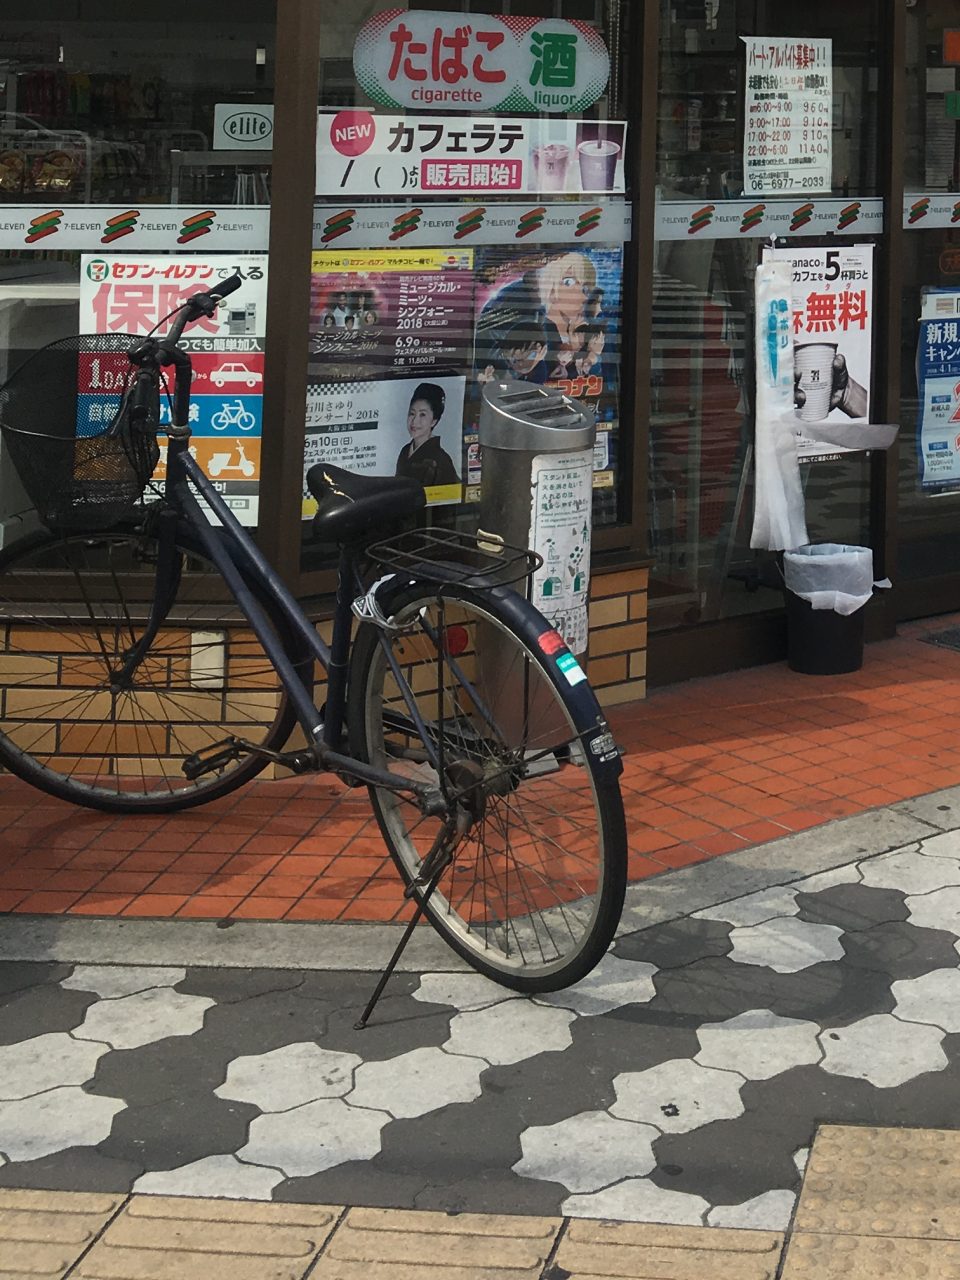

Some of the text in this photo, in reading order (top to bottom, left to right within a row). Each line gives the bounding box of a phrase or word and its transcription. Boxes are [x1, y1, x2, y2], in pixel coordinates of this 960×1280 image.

[387, 22, 579, 88] たばこ 酒
[410, 87, 578, 107] cigarette liquor
[229, 115, 267, 137] elite
[335, 123, 372, 143] NEW
[386, 121, 525, 154] カフェラテ
[791, 258, 821, 268] anaco
[824, 250, 841, 281] 5
[397, 307, 454, 318] シンフォニー
[396, 318, 423, 330] 2018
[395, 336, 414, 348] 6.9
[556, 374, 604, 397] コナン
[355, 409, 380, 421] 2018
